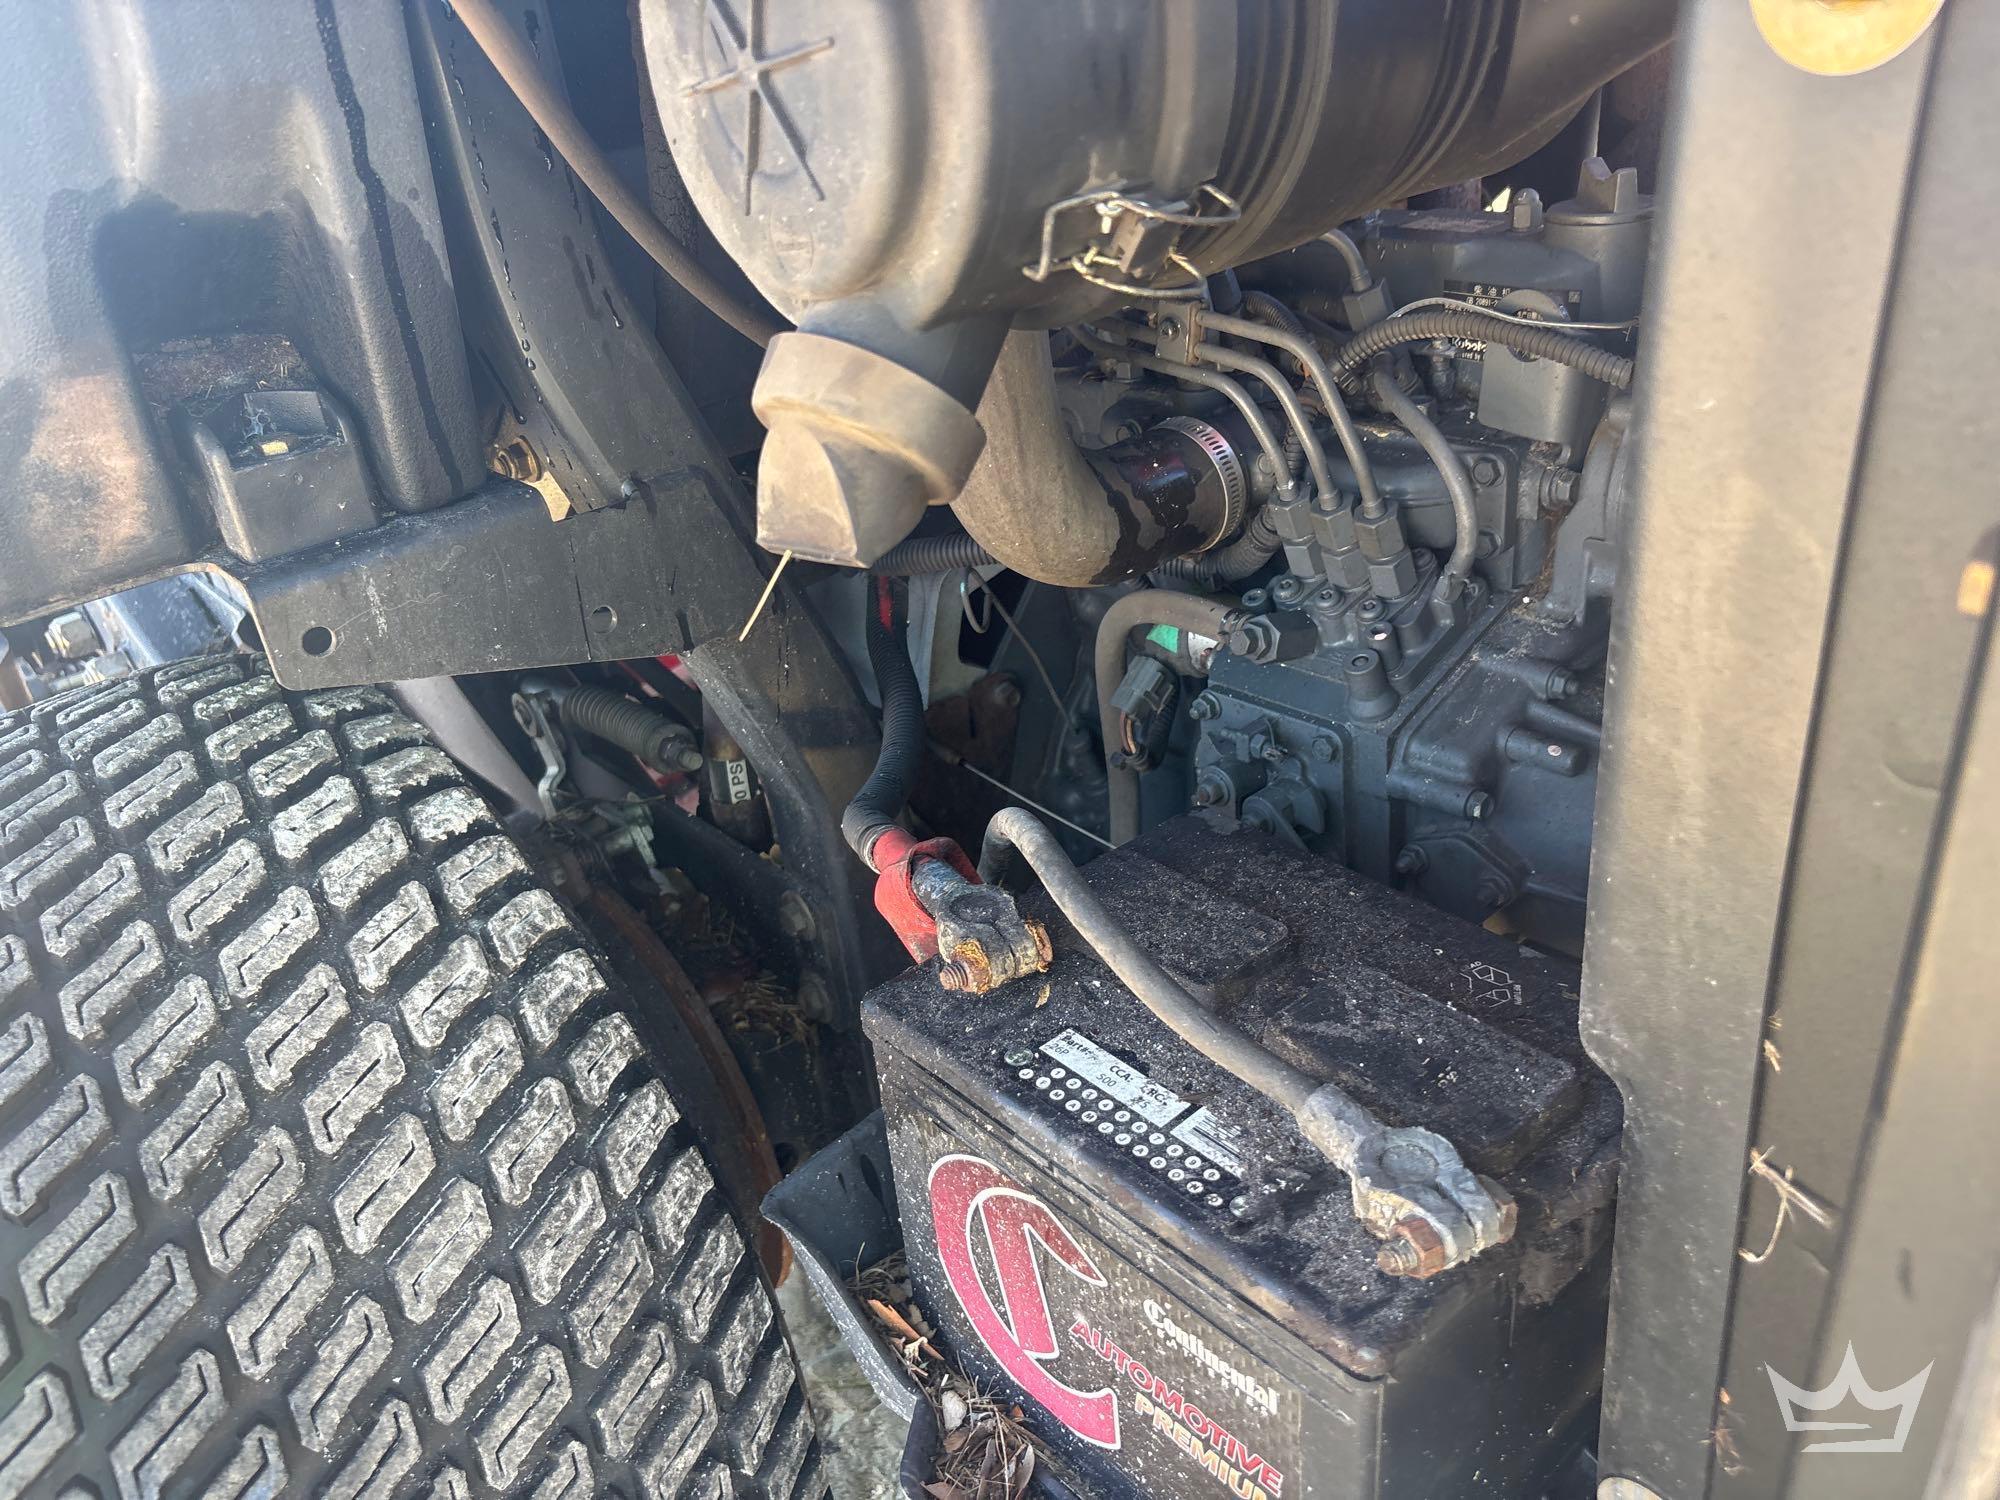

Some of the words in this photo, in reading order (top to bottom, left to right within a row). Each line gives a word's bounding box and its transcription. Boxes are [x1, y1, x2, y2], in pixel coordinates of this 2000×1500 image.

[1096, 1073, 1117, 1087] 500
[1109, 1065, 1133, 1083] CCA:
[1143, 1299, 1279, 1415] Continental
[1069, 1316, 1284, 1498] AUTOMOTIVE
